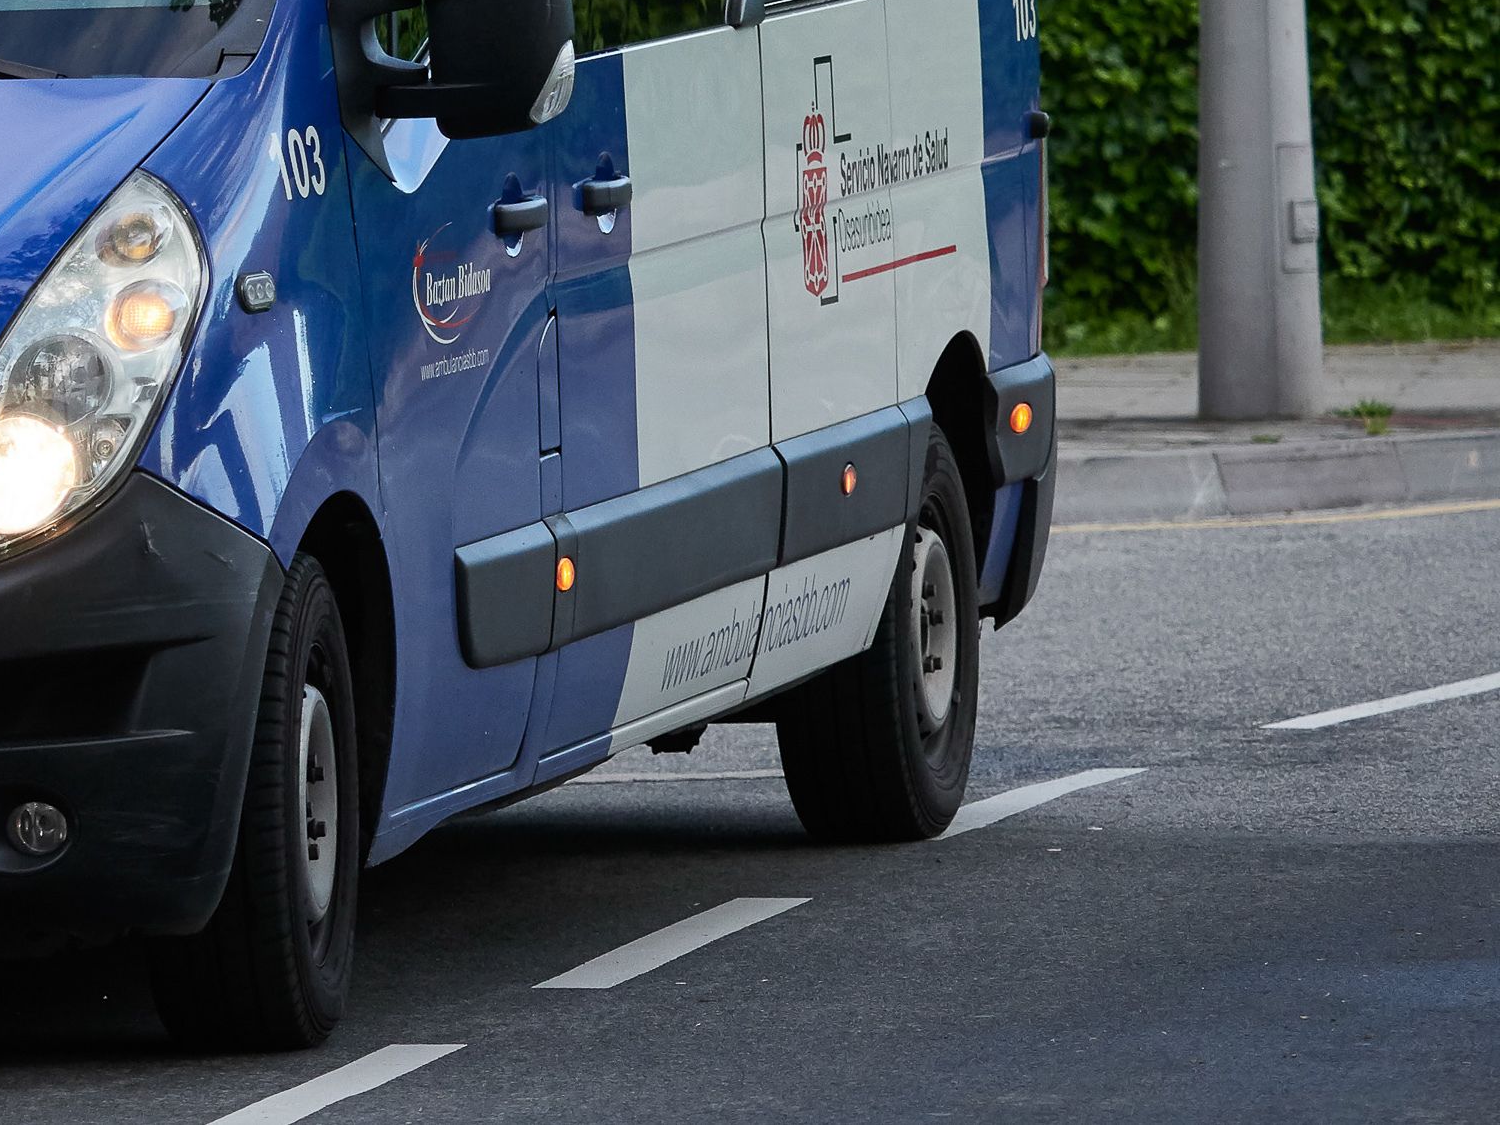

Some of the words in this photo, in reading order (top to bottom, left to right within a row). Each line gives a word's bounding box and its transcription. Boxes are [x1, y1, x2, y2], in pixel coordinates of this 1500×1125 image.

[269, 125, 327, 201] 103
[840, 147, 875, 197] Servicio
[876, 143, 911, 186] Navarro
[912, 134, 923, 177] de
[924, 127, 948, 174] Salud
[426, 273, 456, 307] Baztan
[457, 262, 491, 299] Bidasoa
[420, 348, 490, 381] www.ambulanciasbb.com
[661, 574, 851, 691] www.ambulanciasbb.com
